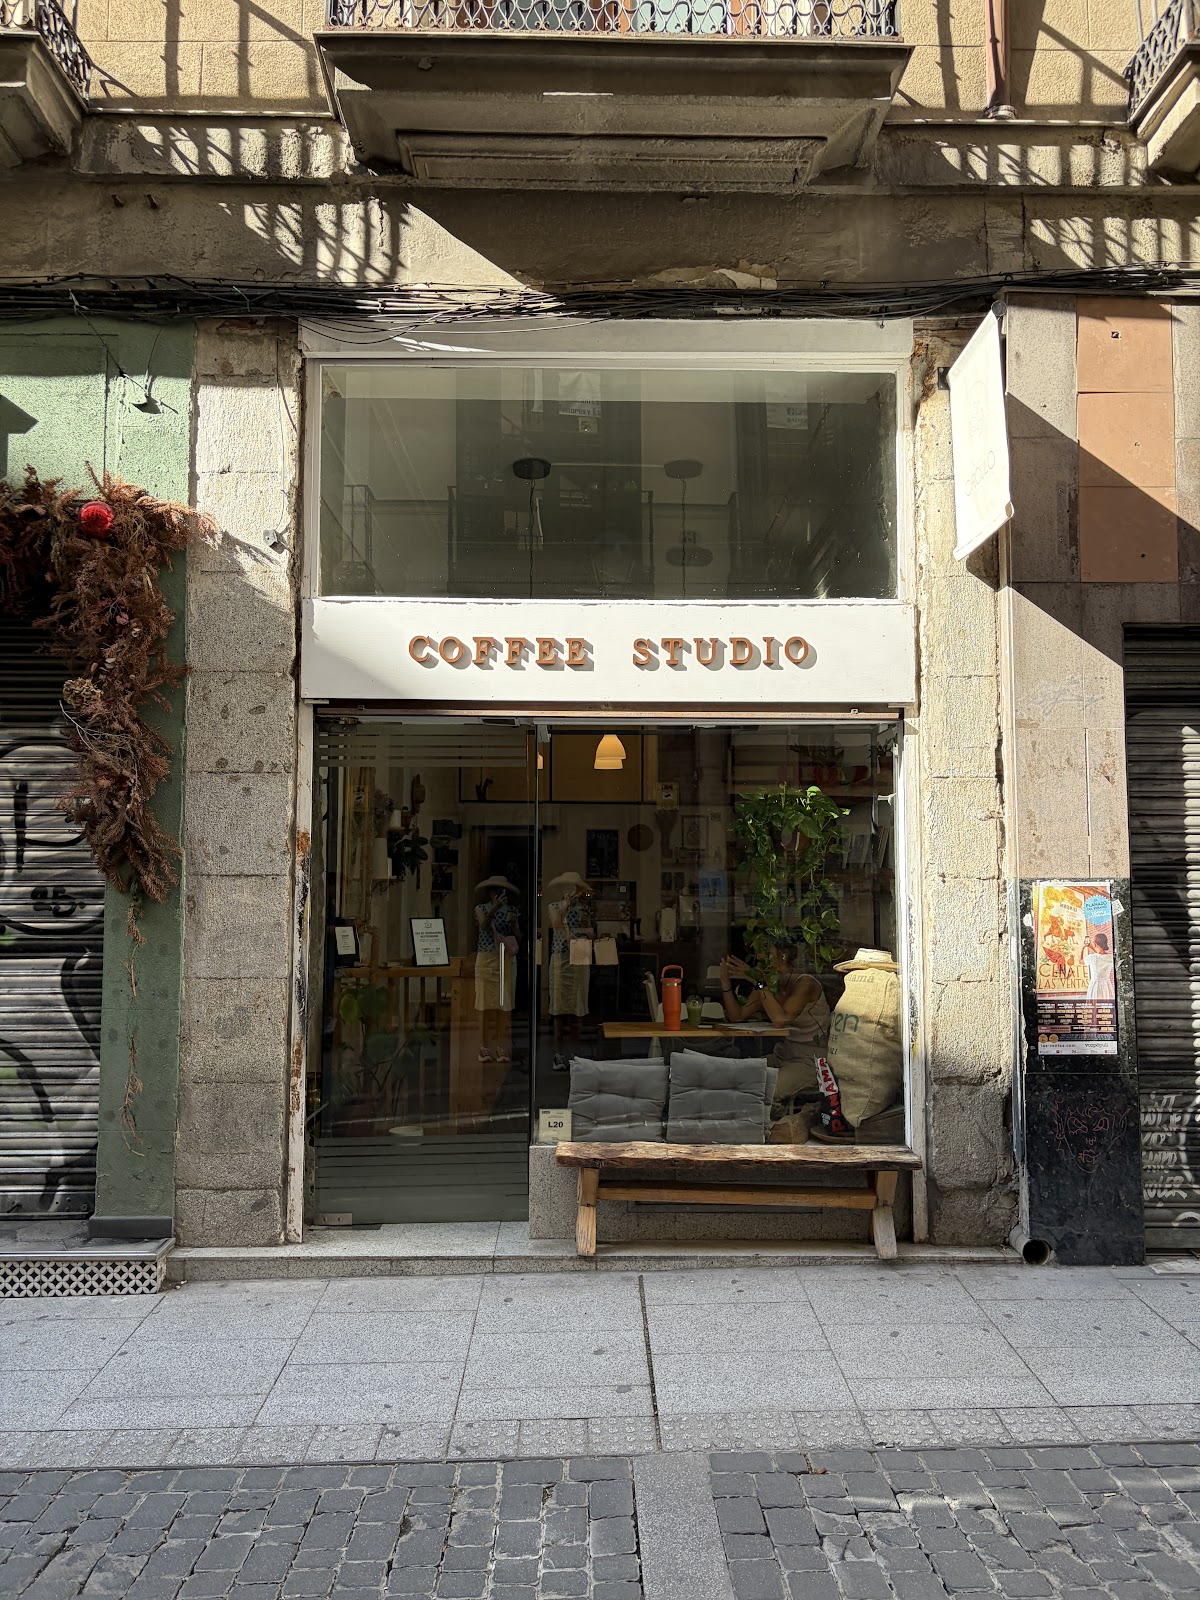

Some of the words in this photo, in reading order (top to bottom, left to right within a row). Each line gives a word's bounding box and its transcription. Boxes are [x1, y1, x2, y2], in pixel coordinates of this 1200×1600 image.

[408, 635, 586, 666] COFFEE
[632, 635, 810, 666] STUDIO
[1038, 978, 1056, 989] LAS
[1058, 977, 1089, 989] VENTAS
[820, 1057, 846, 1132] PANAMA
